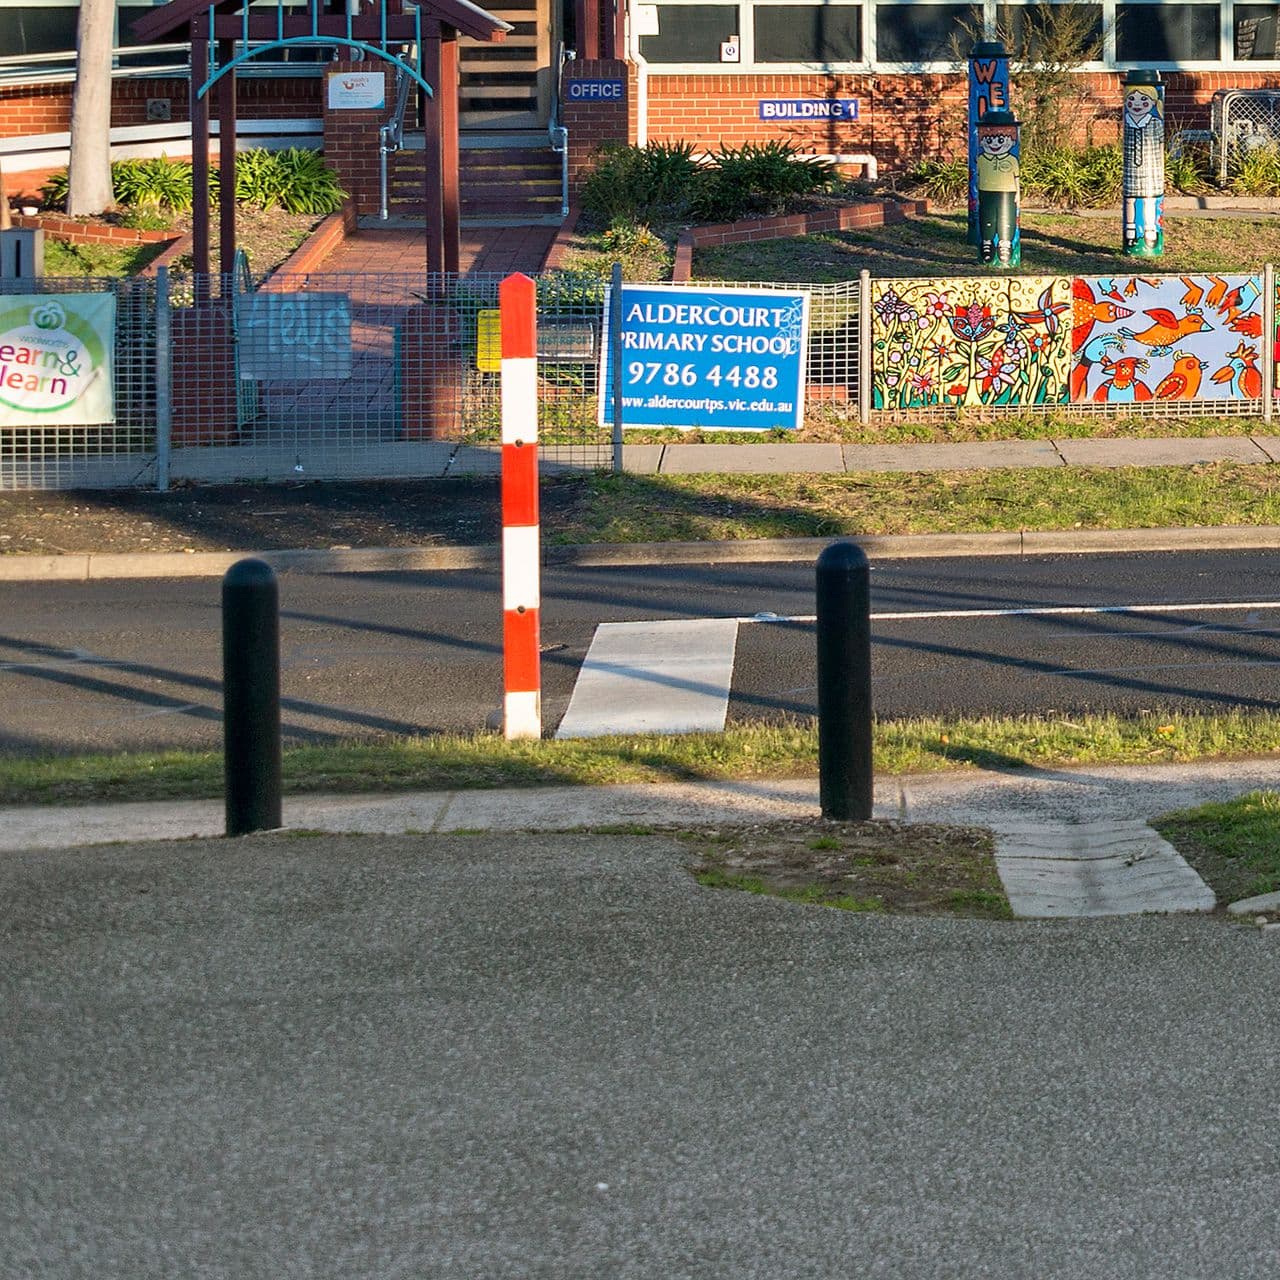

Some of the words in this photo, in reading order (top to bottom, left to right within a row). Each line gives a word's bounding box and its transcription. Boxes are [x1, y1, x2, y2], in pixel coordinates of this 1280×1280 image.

[570, 83, 622, 97] OFFICE
[763, 102, 843, 118] BUILDING
[847, 102, 856, 117] 1
[626, 303, 787, 329] ALDERCOURT
[620, 331, 707, 353] RIMARY
[711, 334, 796, 356] SCHOOL
[0, 365, 67, 396] learn
[628, 361, 698, 387] 9786
[705, 364, 779, 390] 4488
[611, 395, 793, 415] ww.aldercourtps.vic.edu.au
